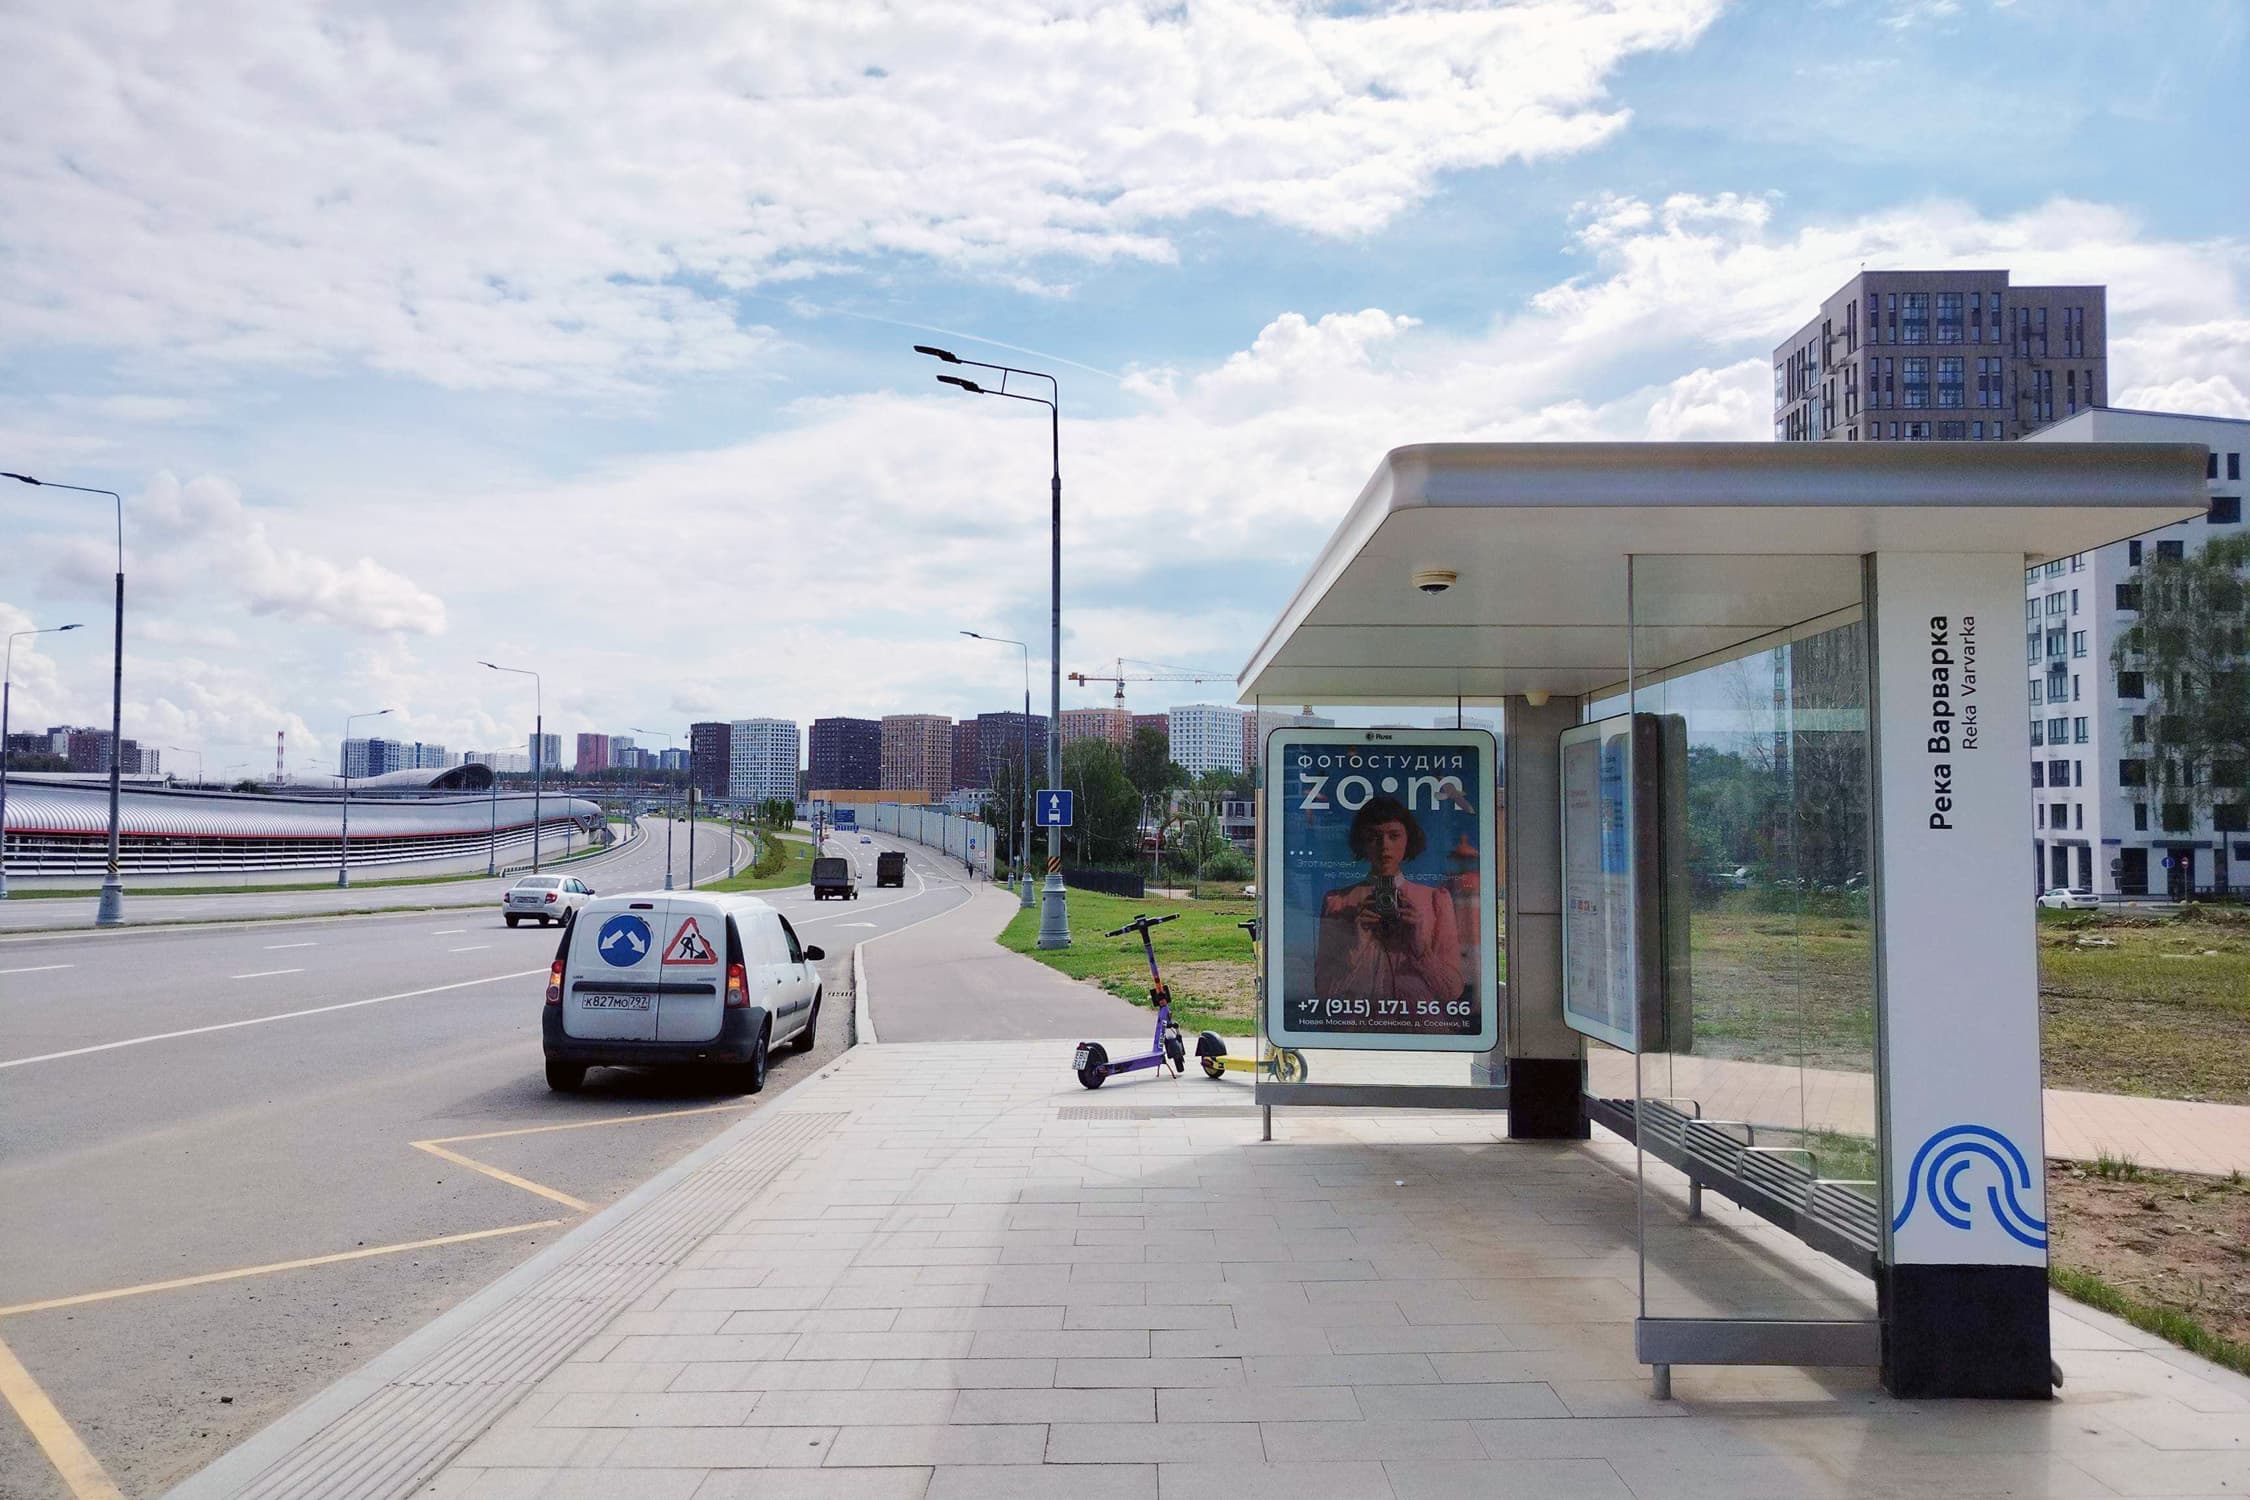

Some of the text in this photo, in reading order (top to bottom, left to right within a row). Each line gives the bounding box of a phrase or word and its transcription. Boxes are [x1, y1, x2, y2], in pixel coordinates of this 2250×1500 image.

[1959, 615, 1978, 750] Reka Varvarka
[1927, 615, 1955, 830] Река Варварка
[1297, 754, 1464, 771] ФОТОСТУДИЯ
[1298, 998, 1471, 1017] +7 (915) 171 56 66
[1298, 1018, 1323, 1026] Новая
